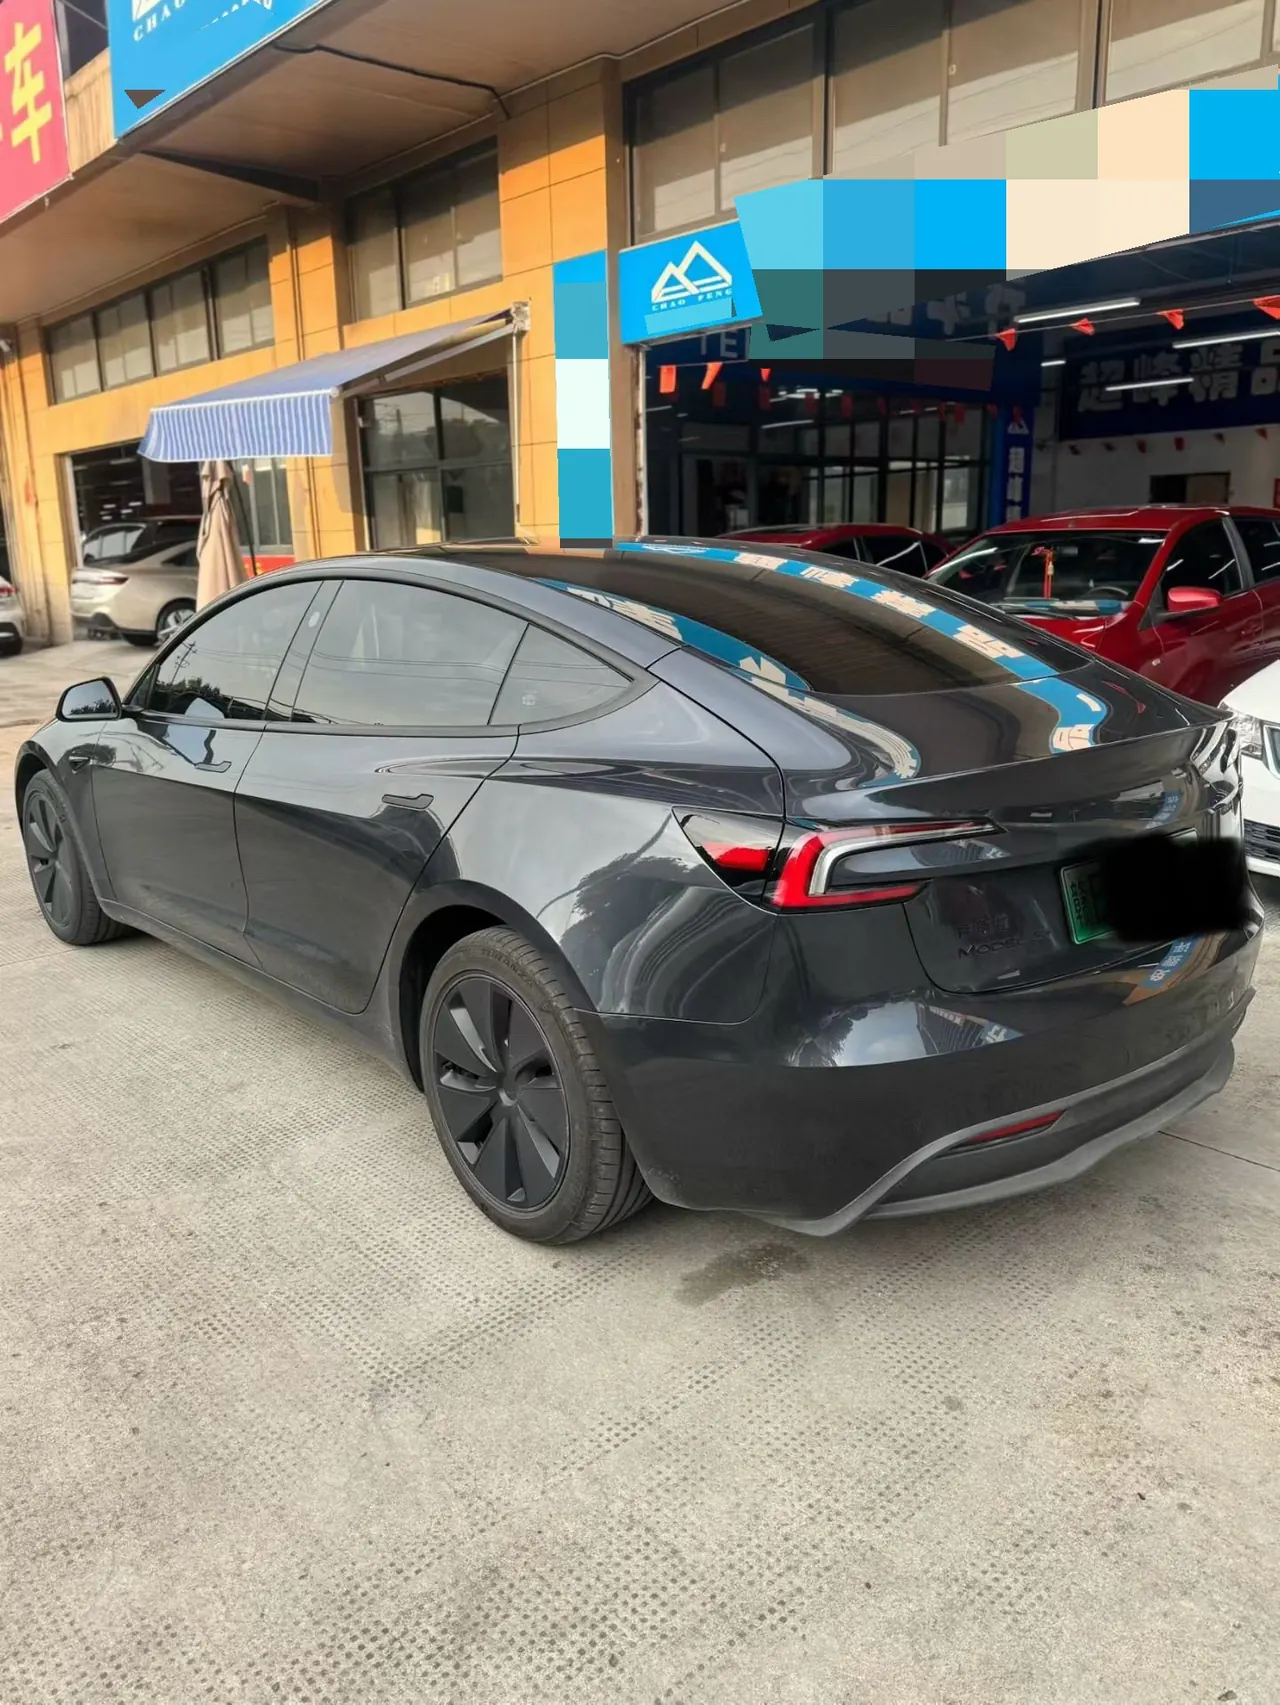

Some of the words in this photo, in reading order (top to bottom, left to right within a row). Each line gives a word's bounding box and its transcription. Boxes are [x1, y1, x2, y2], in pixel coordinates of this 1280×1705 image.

[4, 22, 53, 164] 车
[652, 300, 686, 312] CHAO
[698, 289, 732, 302] FENG
